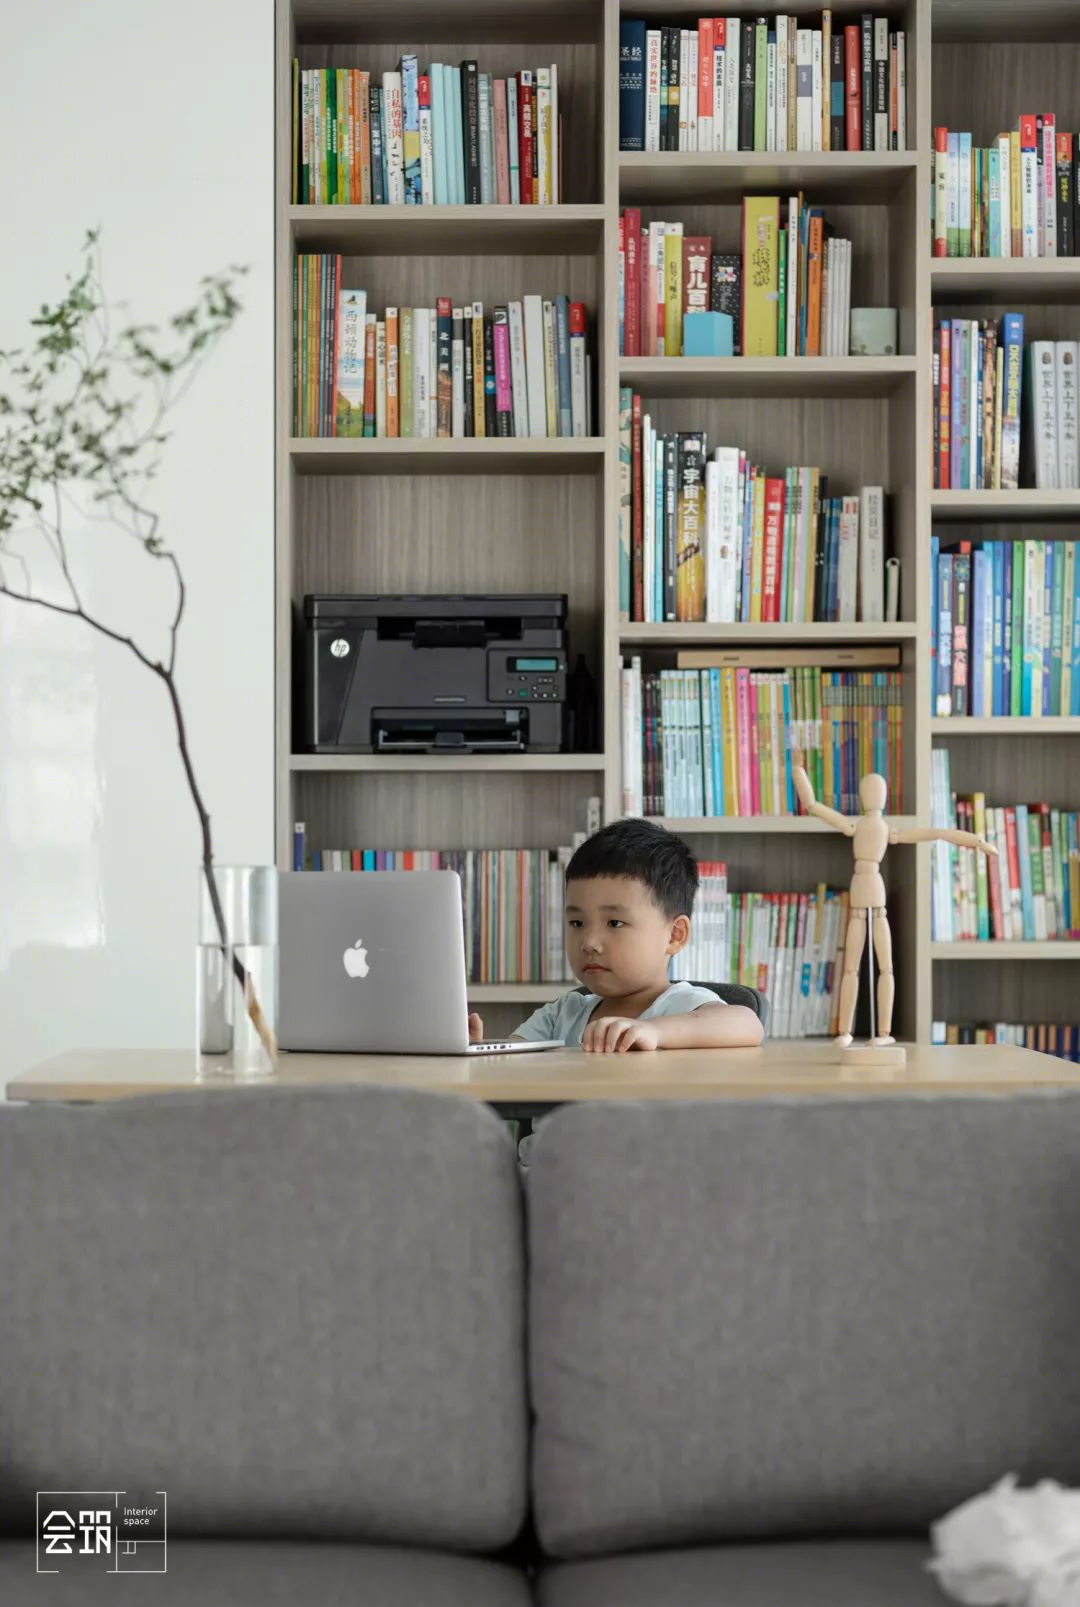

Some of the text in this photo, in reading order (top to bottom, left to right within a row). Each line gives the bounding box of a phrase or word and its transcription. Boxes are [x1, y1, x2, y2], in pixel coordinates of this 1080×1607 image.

[683, 468, 701, 547] 宇宙大百科
[332, 639, 348, 657] hp
